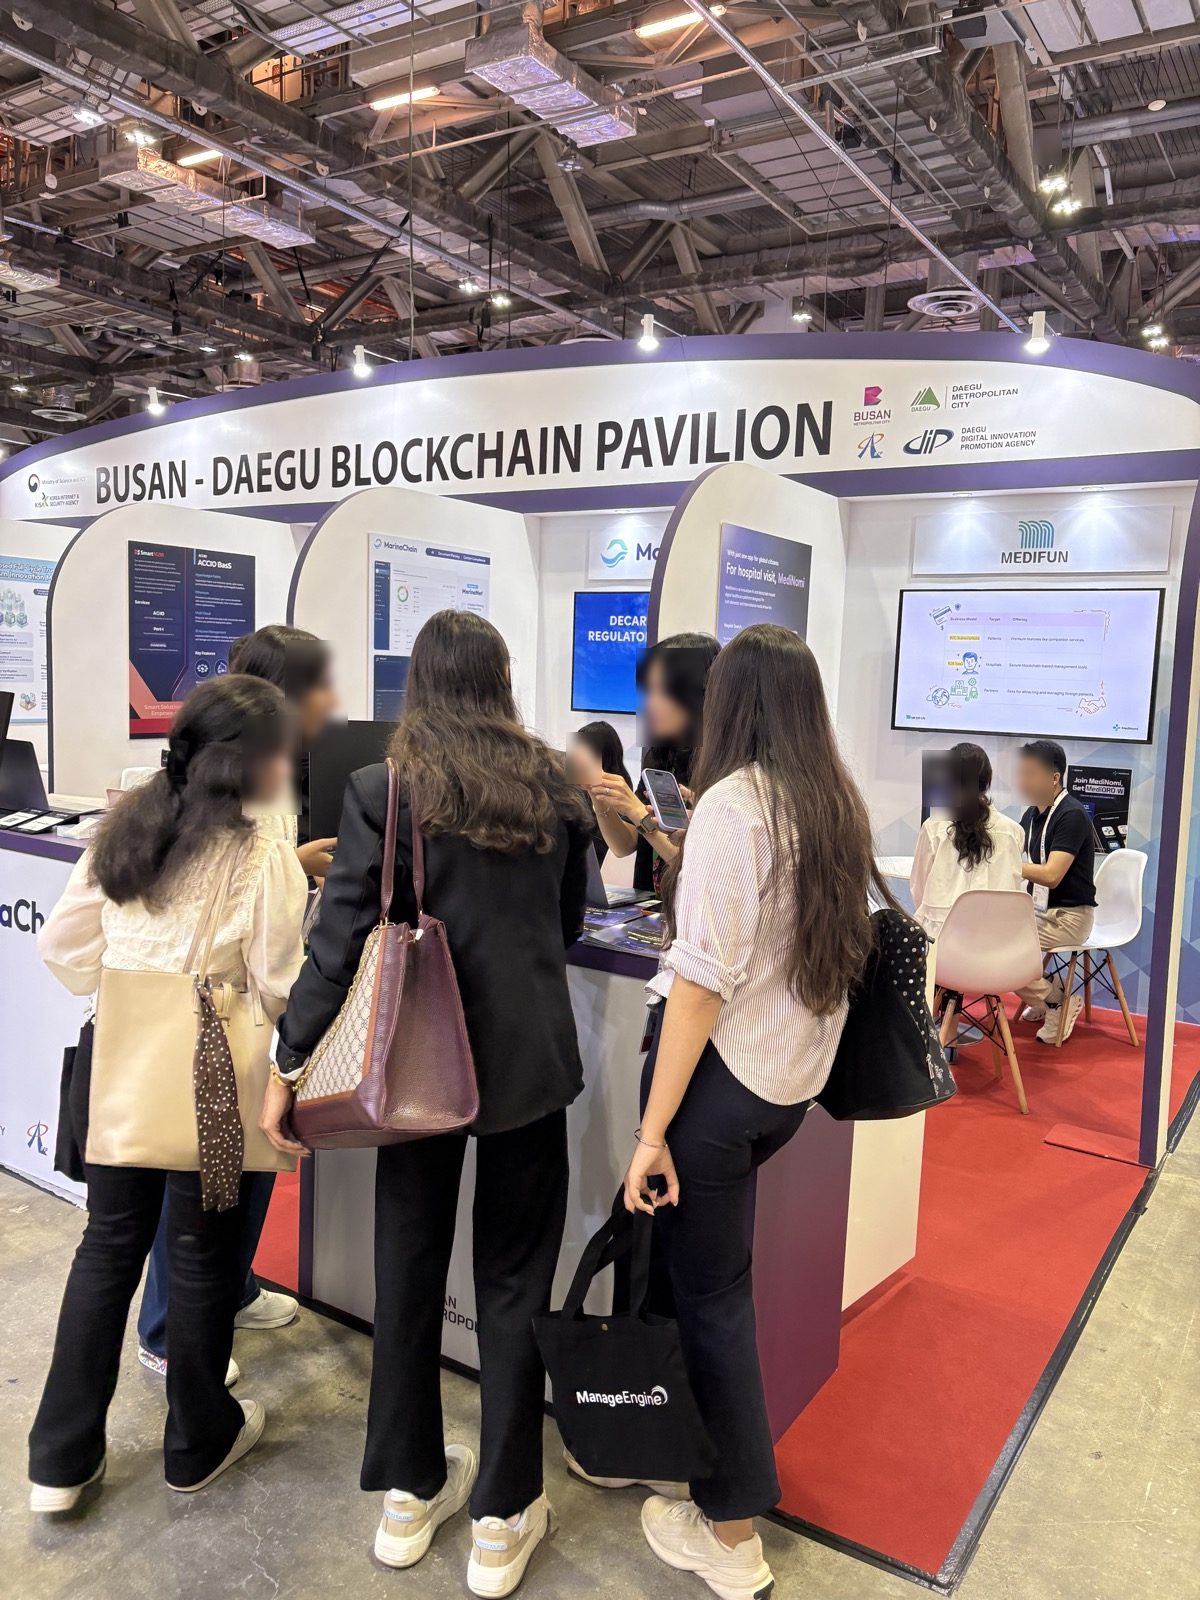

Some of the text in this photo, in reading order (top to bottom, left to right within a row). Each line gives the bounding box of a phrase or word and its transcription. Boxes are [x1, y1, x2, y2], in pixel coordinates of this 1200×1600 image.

[952, 384, 982, 392] DAEGU
[952, 388, 1018, 400] METROPOLITAN
[854, 410, 891, 422] BUSAN
[960, 430, 1036, 442] DIGITAL INNOVATION
[962, 426, 986, 434] DAEGU
[960, 440, 1036, 450] PROMOTION AGENCY
[96, 460, 186, 504] BUSAN
[212, 447, 320, 496] DAEGU
[332, 424, 582, 488] BLOCKCHAIN
[596, 400, 833, 471] PAVILION
[1001, 550, 1068, 564] MEDIFUN
[726, 562, 736, 575] For
[738, 564, 762, 581] hospital
[763, 570, 776, 584] visit,
[609, 616, 647, 626] DECAR
[588, 631, 647, 642] REGULATO
[576, 1390, 662, 1407] ManageEngine
